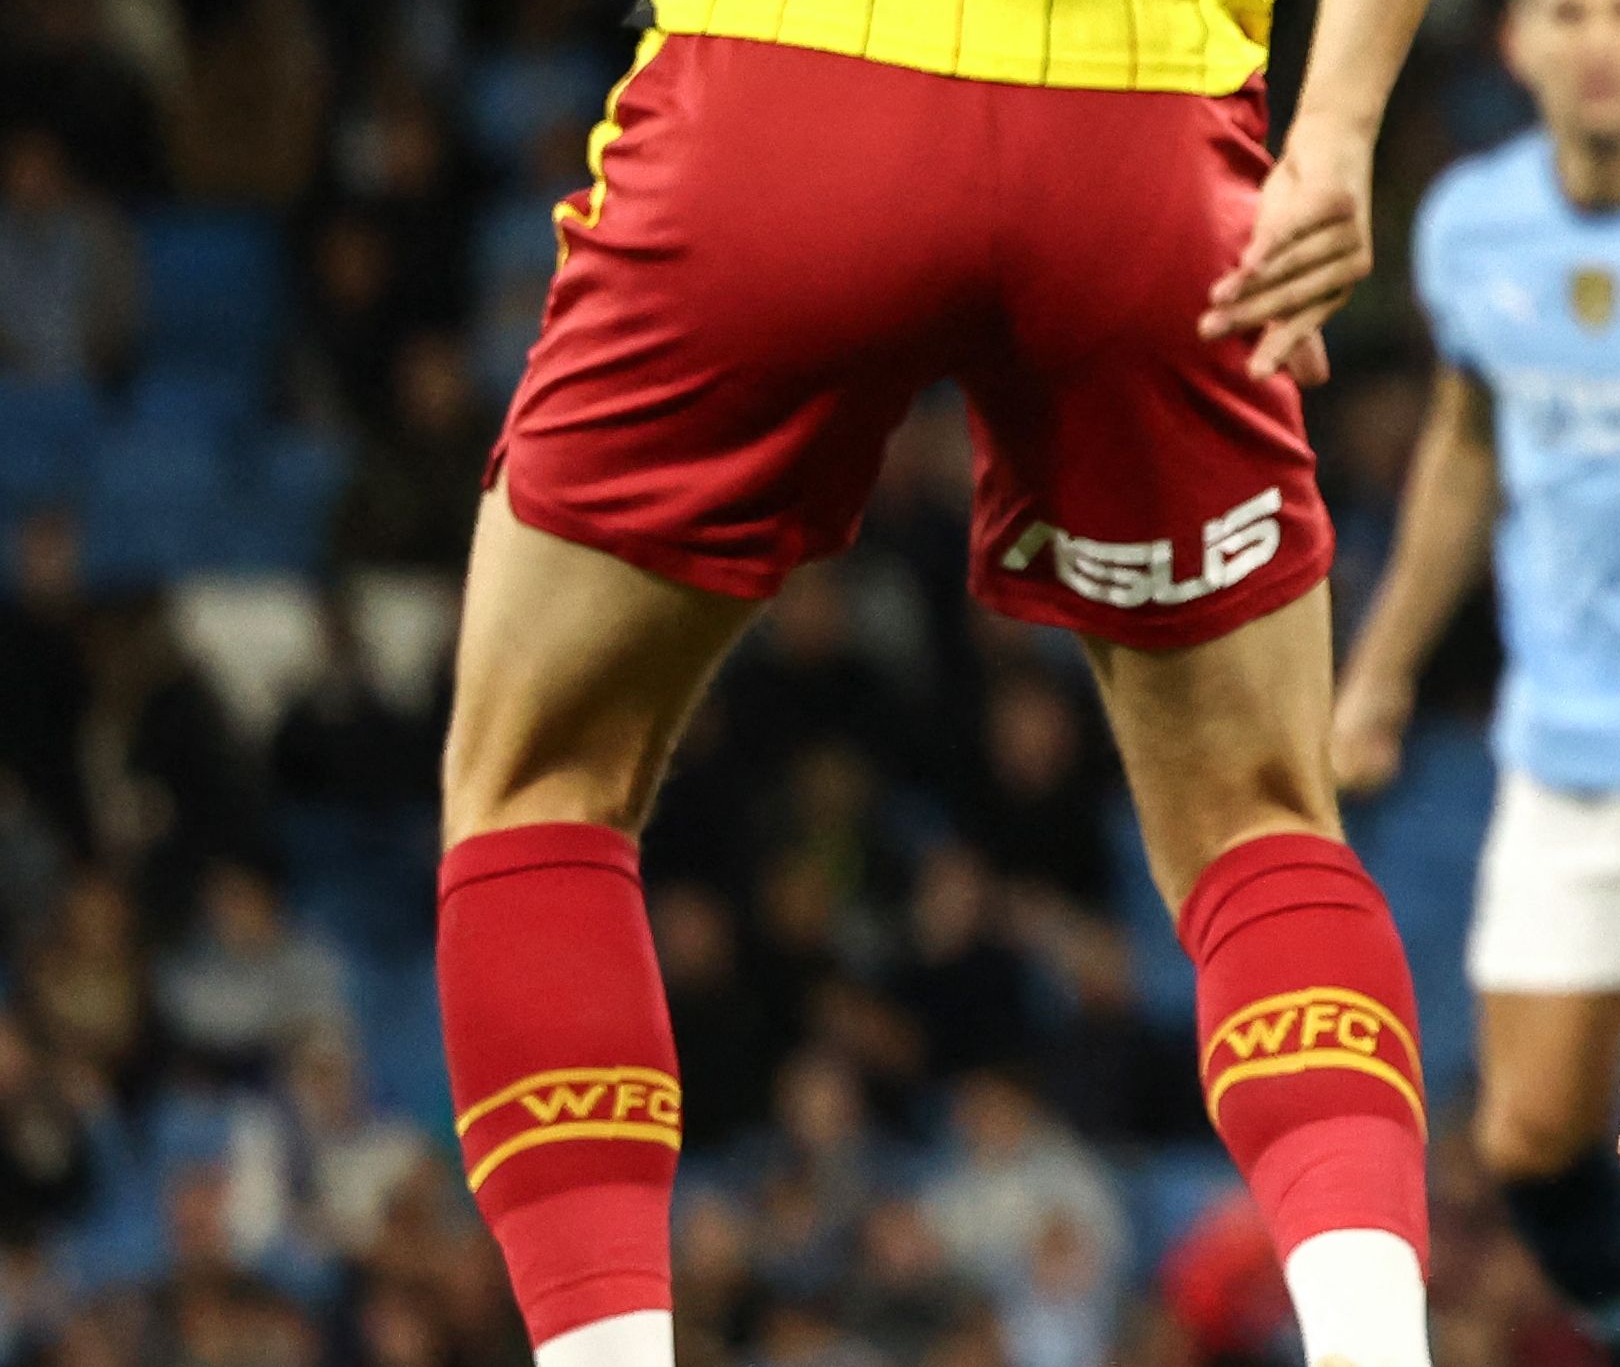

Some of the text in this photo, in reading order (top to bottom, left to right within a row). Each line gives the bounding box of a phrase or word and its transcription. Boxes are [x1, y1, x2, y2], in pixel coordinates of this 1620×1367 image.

[1002, 486, 1282, 609] ASUS
[1222, 1003, 1382, 1060] WFC
[519, 1083, 683, 1126] WFC
